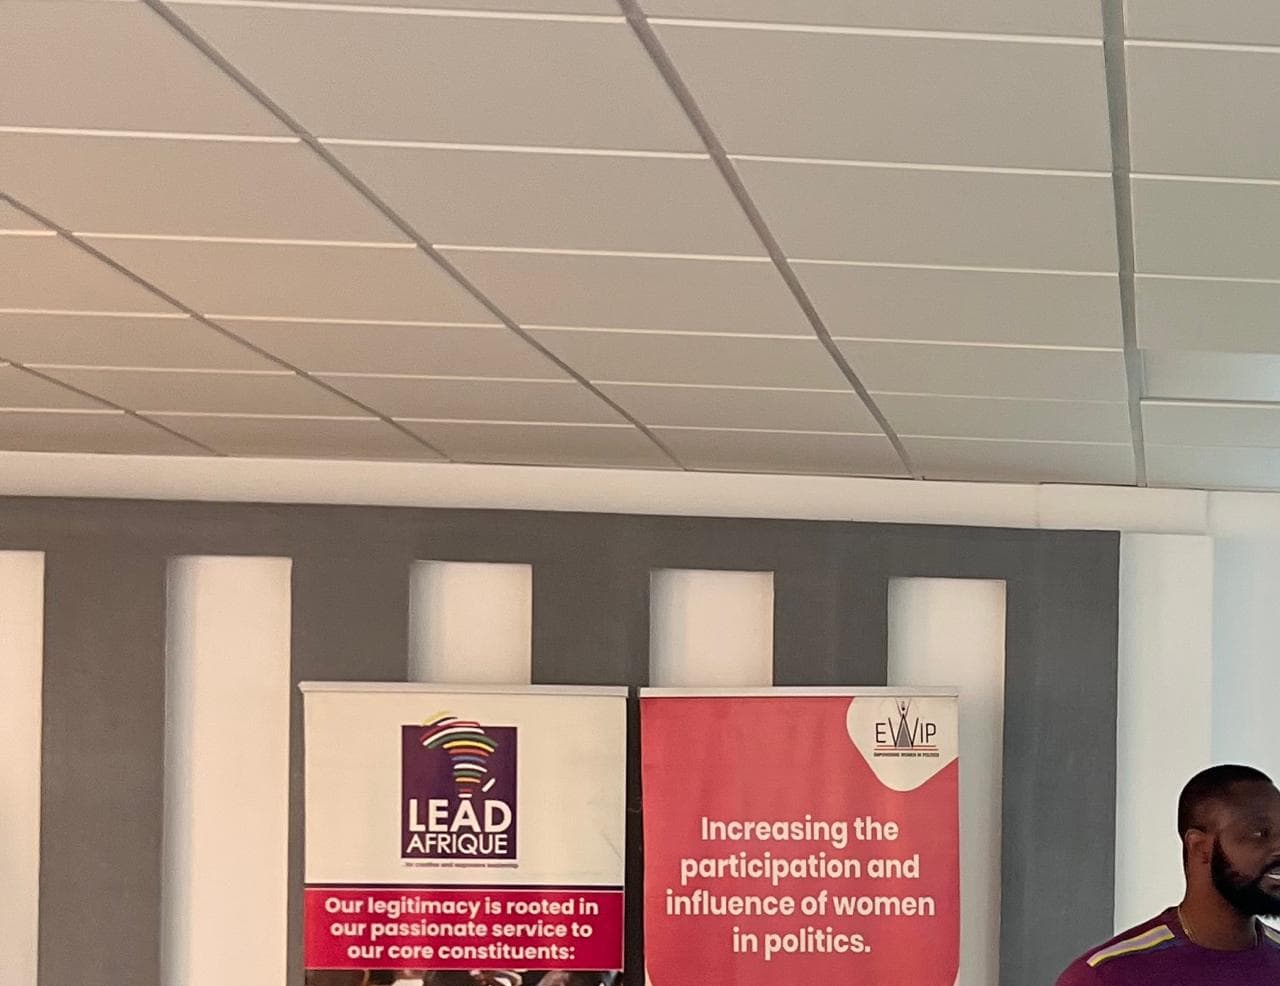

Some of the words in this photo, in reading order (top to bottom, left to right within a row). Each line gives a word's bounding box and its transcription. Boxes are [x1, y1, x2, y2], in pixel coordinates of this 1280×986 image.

[875, 713, 937, 747] EWIP
[409, 798, 512, 832] LEAD
[406, 833, 507, 855] AFRIQUE
[701, 814, 848, 849] Increasing
[853, 816, 899, 840] the
[680, 851, 861, 886] participation
[867, 854, 919, 878] and
[325, 897, 363, 914] Our
[368, 897, 478, 919] legitimacy
[484, 897, 502, 915] is
[506, 898, 574, 916] rooted
[579, 897, 599, 916] in
[666, 888, 795, 916] influence
[801, 890, 828, 915] of
[833, 896, 935, 916] women
[330, 922, 366, 936] our
[370, 920, 488, 941] passionate
[491, 920, 567, 937] service
[571, 921, 593, 937] to
[733, 926, 758, 952] in
[765, 926, 871, 960] politics.
[347, 945, 383, 959] our
[388, 945, 434, 959] core
[438, 942, 576, 960] constituents:
